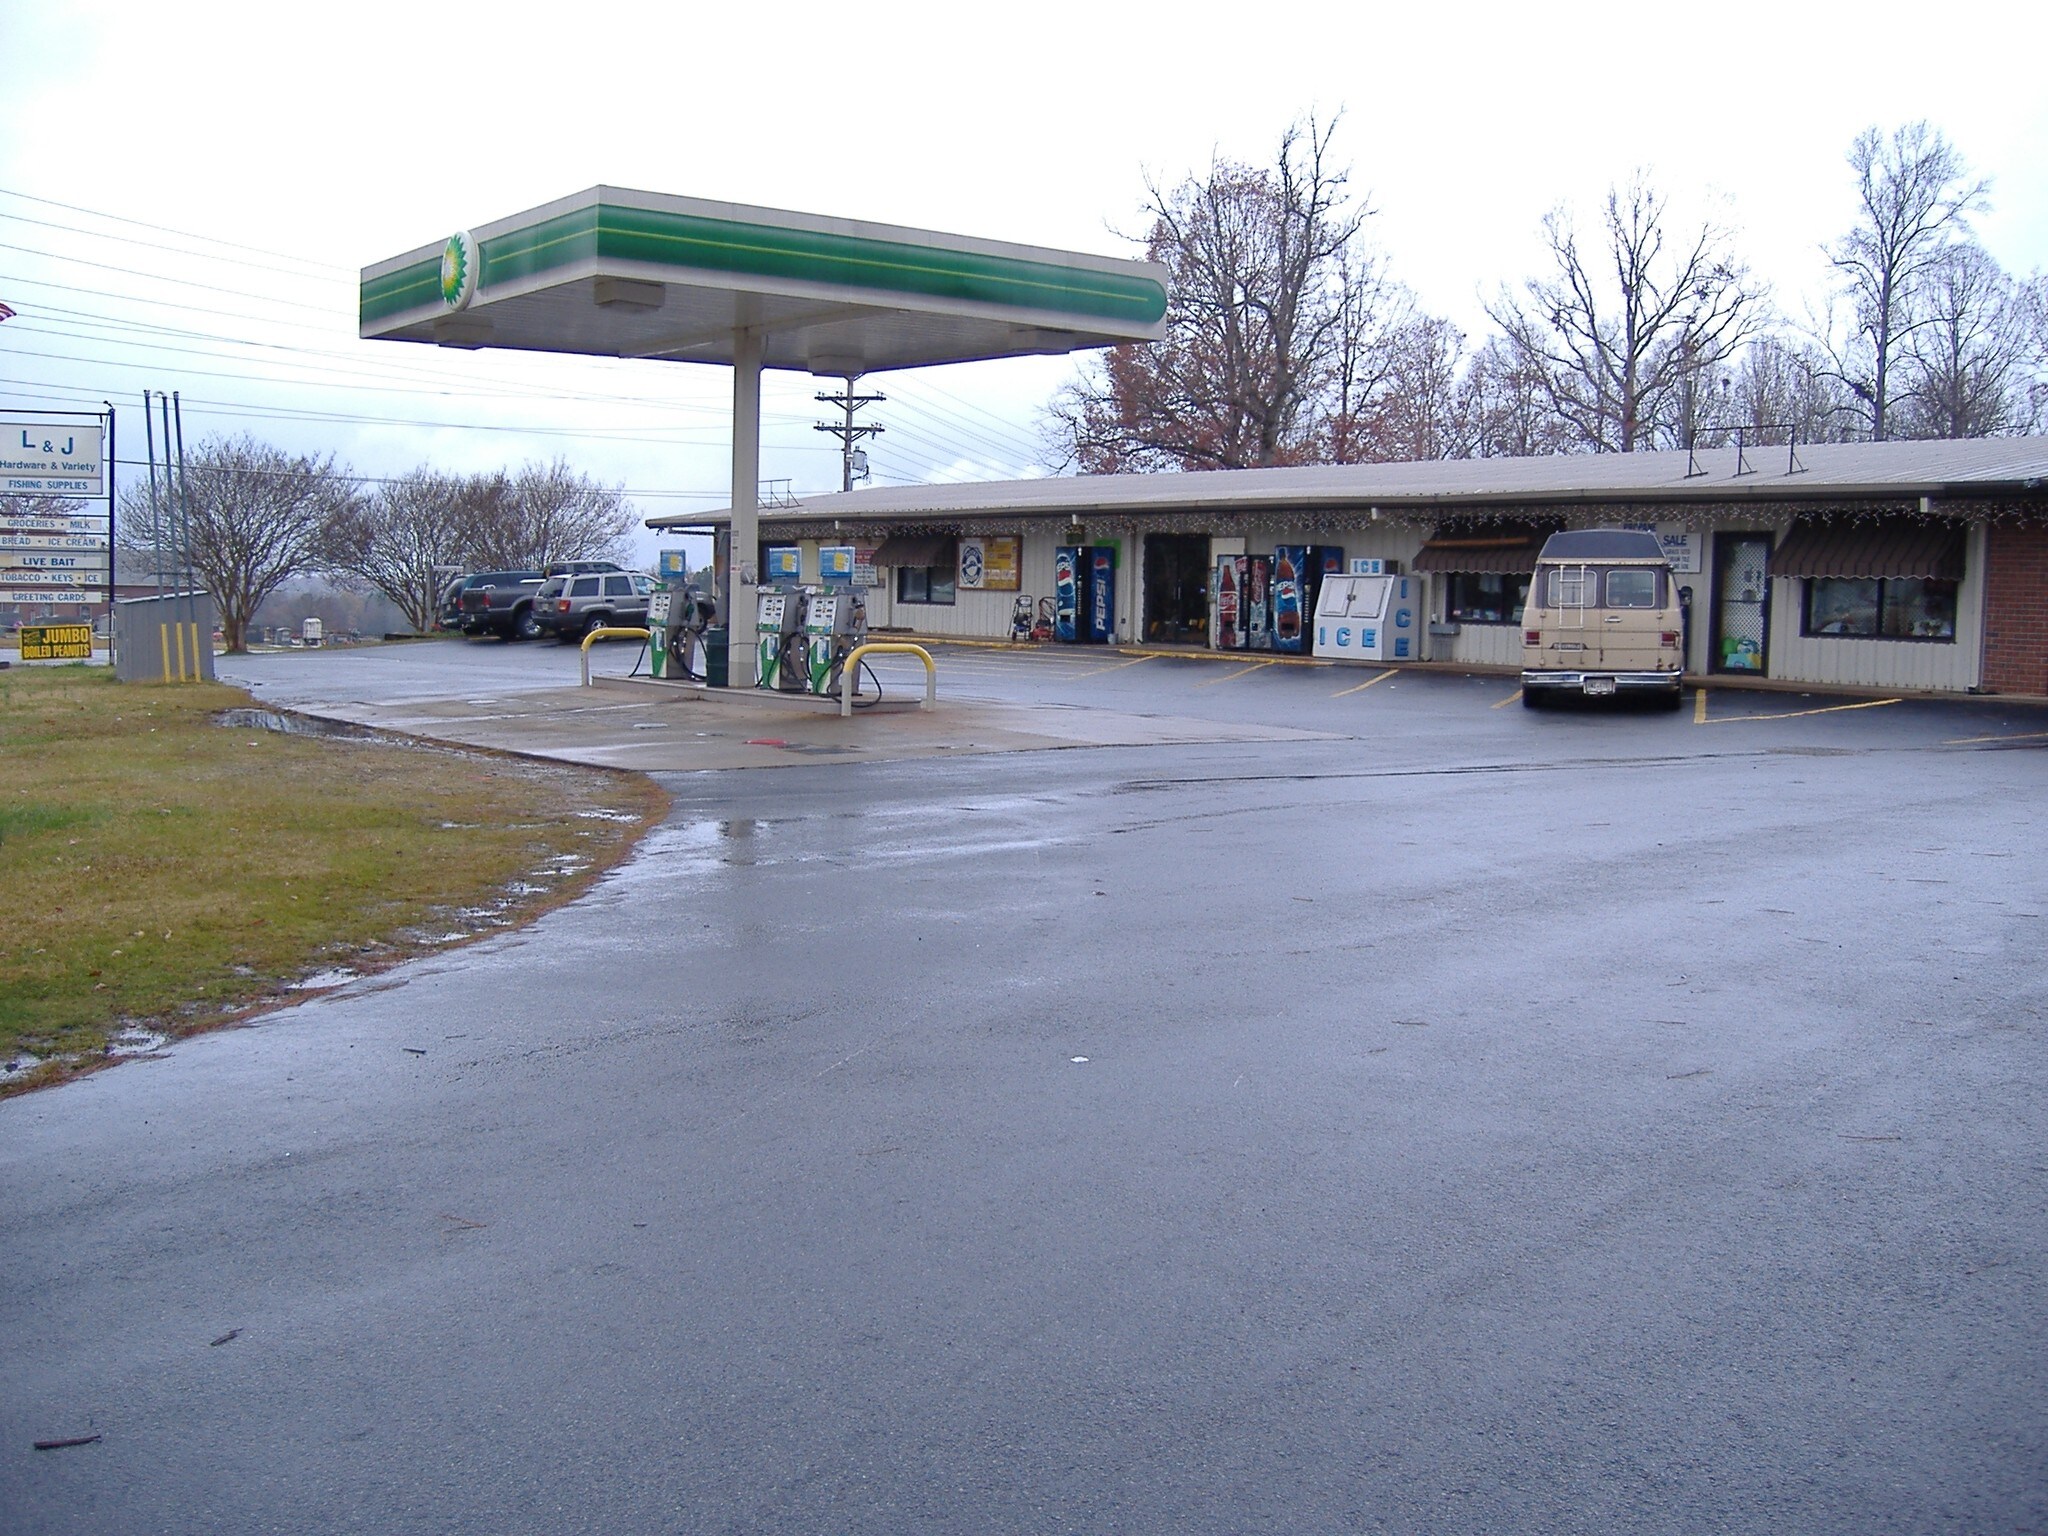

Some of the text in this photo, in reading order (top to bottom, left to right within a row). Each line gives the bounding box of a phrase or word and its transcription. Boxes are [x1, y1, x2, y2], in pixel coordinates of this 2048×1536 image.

[22, 430, 73, 455] L & J
[0, 460, 96, 472] Hardware & Variety
[8, 480, 88, 490] FISHING SUPPLIES
[7, 519, 91, 529] GROCERIES MILK
[1, 536, 96, 547] BREAD ICE CREAM
[1663, 535, 1688, 546] SALE
[23, 557, 76, 567] LIVE BAIT
[1353, 560, 1380, 574] ICE
[0, 573, 99, 583] TOBACCO KEYS ICE
[12, 593, 87, 602] GREETING CARDS
[1096, 579, 1106, 631] PEPSI
[1394, 579, 1412, 658] ICE
[42, 627, 89, 644] JUMBO
[1319, 626, 1377, 648] ICE
[23, 643, 90, 659] BOILED PEANUTS
